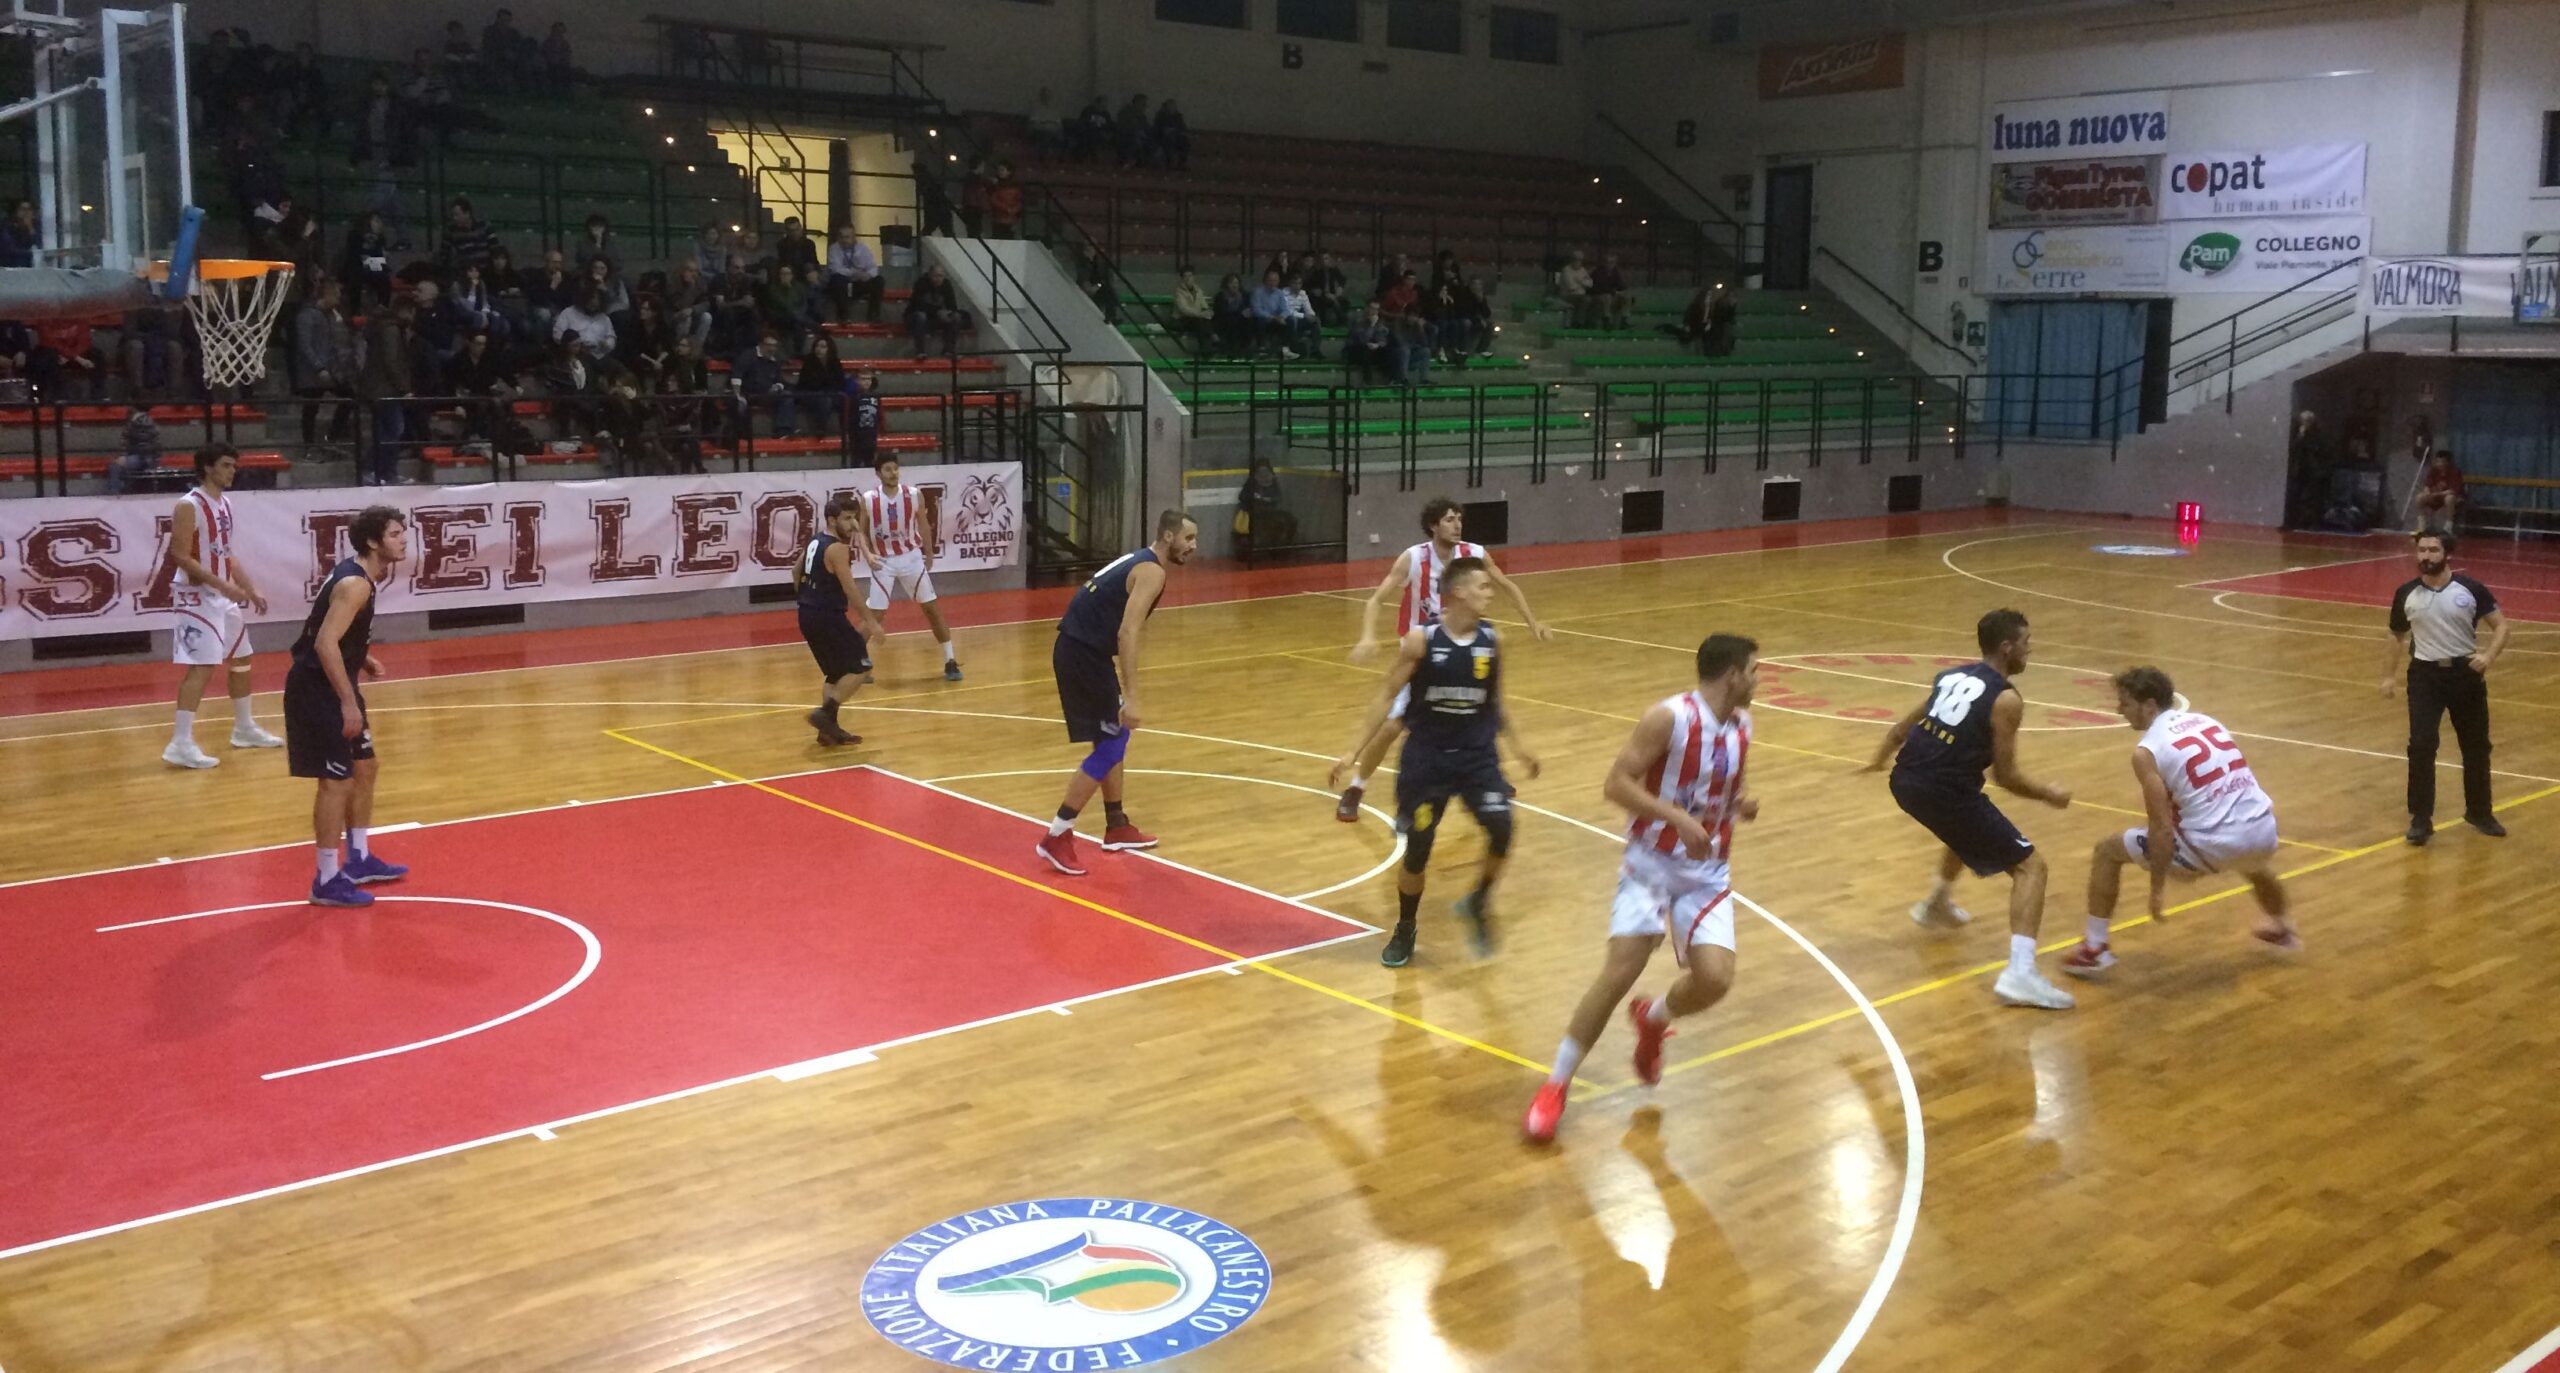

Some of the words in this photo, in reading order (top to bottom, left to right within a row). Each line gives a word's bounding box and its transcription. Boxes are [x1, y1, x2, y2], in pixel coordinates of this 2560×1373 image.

[1676, 120, 1697, 148] B
[1994, 113, 2062, 150] luna
[2068, 111, 2167, 146] nuova
[2171, 154, 2266, 197] copat
[2213, 198, 2279, 213] human
[2291, 190, 2359, 210] inside
[1919, 241, 1944, 272] B
[2190, 244, 2230, 262] Pam
[2256, 235, 2361, 252] COLLEGNO
[2373, 265, 2462, 306] VALMORA
[589, 483, 947, 584] LEOI
[953, 530, 1014, 545] COLLEGNO
[960, 545, 1009, 559] BASKET
[177, 591, 202, 607] 33
[1928, 671, 1987, 727] 18
[2171, 725, 2248, 790] 25
[875, 1201, 1050, 1273] ITALIANA
[1087, 1199, 1266, 1332] PALLACANESTRO
[866, 1289, 1142, 1372] FEDERAZIONE
